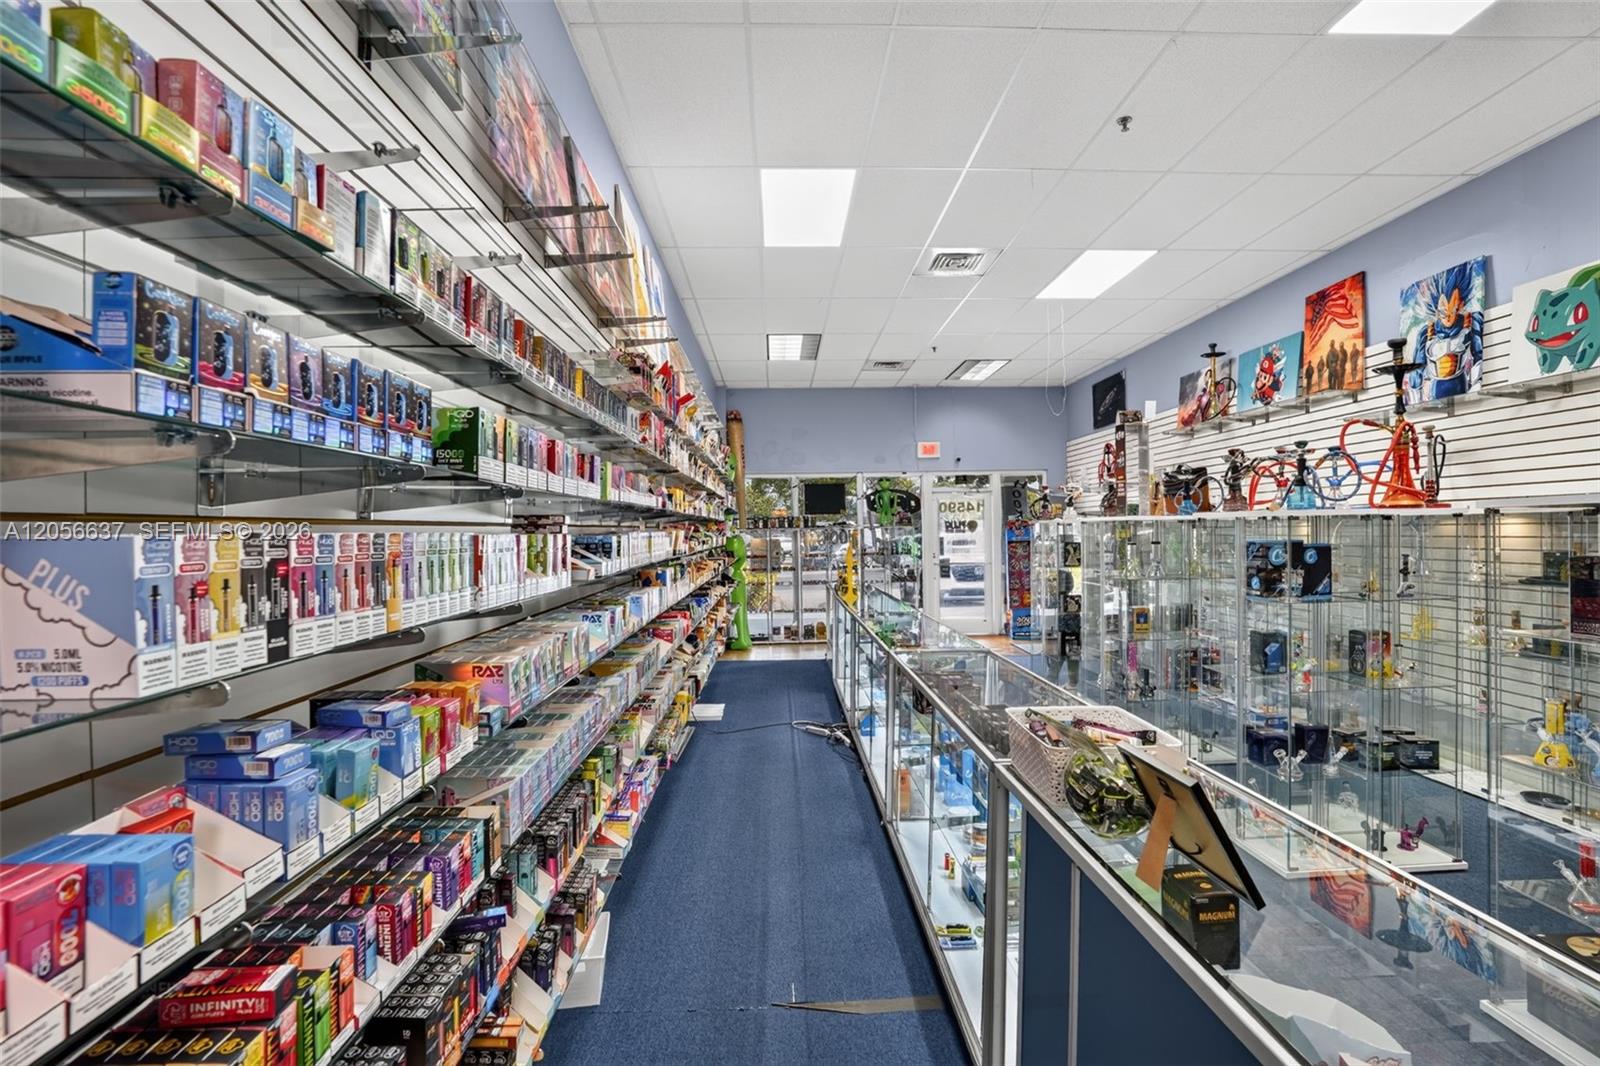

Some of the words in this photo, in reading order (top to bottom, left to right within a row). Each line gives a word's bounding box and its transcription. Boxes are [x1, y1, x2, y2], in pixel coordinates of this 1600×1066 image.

[27, 557, 91, 612] PLUS
[41, 661, 83, 673] NICOTINE
[471, 665, 505, 678] RAZ
[168, 736, 199, 747] HQD
[274, 791, 285, 822] HQD
[1199, 910, 1236, 922] MAGNUM
[59, 909, 80, 968] 7000
[383, 923, 392, 964] INFINIT
[189, 998, 256, 1014] INFINITY
